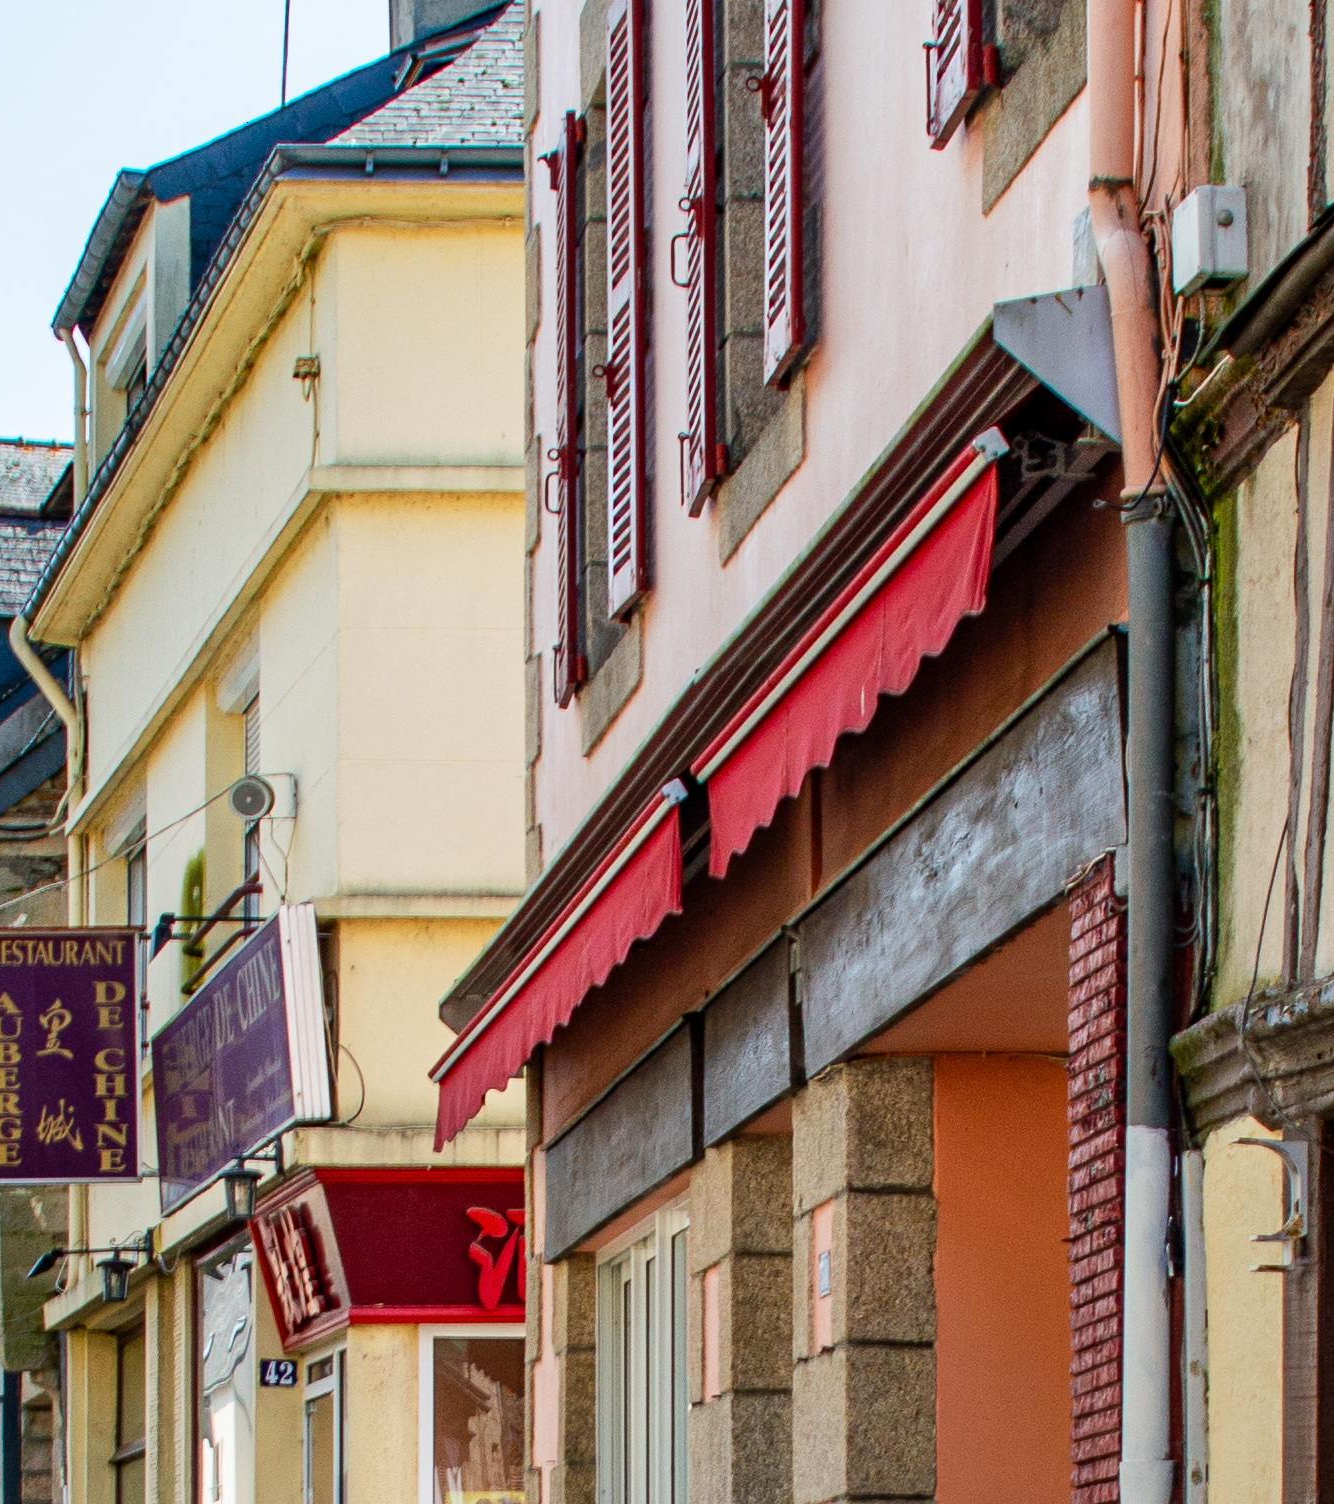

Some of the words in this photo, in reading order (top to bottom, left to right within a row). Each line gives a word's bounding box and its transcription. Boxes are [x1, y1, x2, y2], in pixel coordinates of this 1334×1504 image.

[92, 981, 127, 1031] DE
[215, 982, 236, 1050] DE
[235, 938, 281, 1032] CHINE
[94, 1048, 128, 1173] CHINE
[265, 1360, 294, 1385] 42
